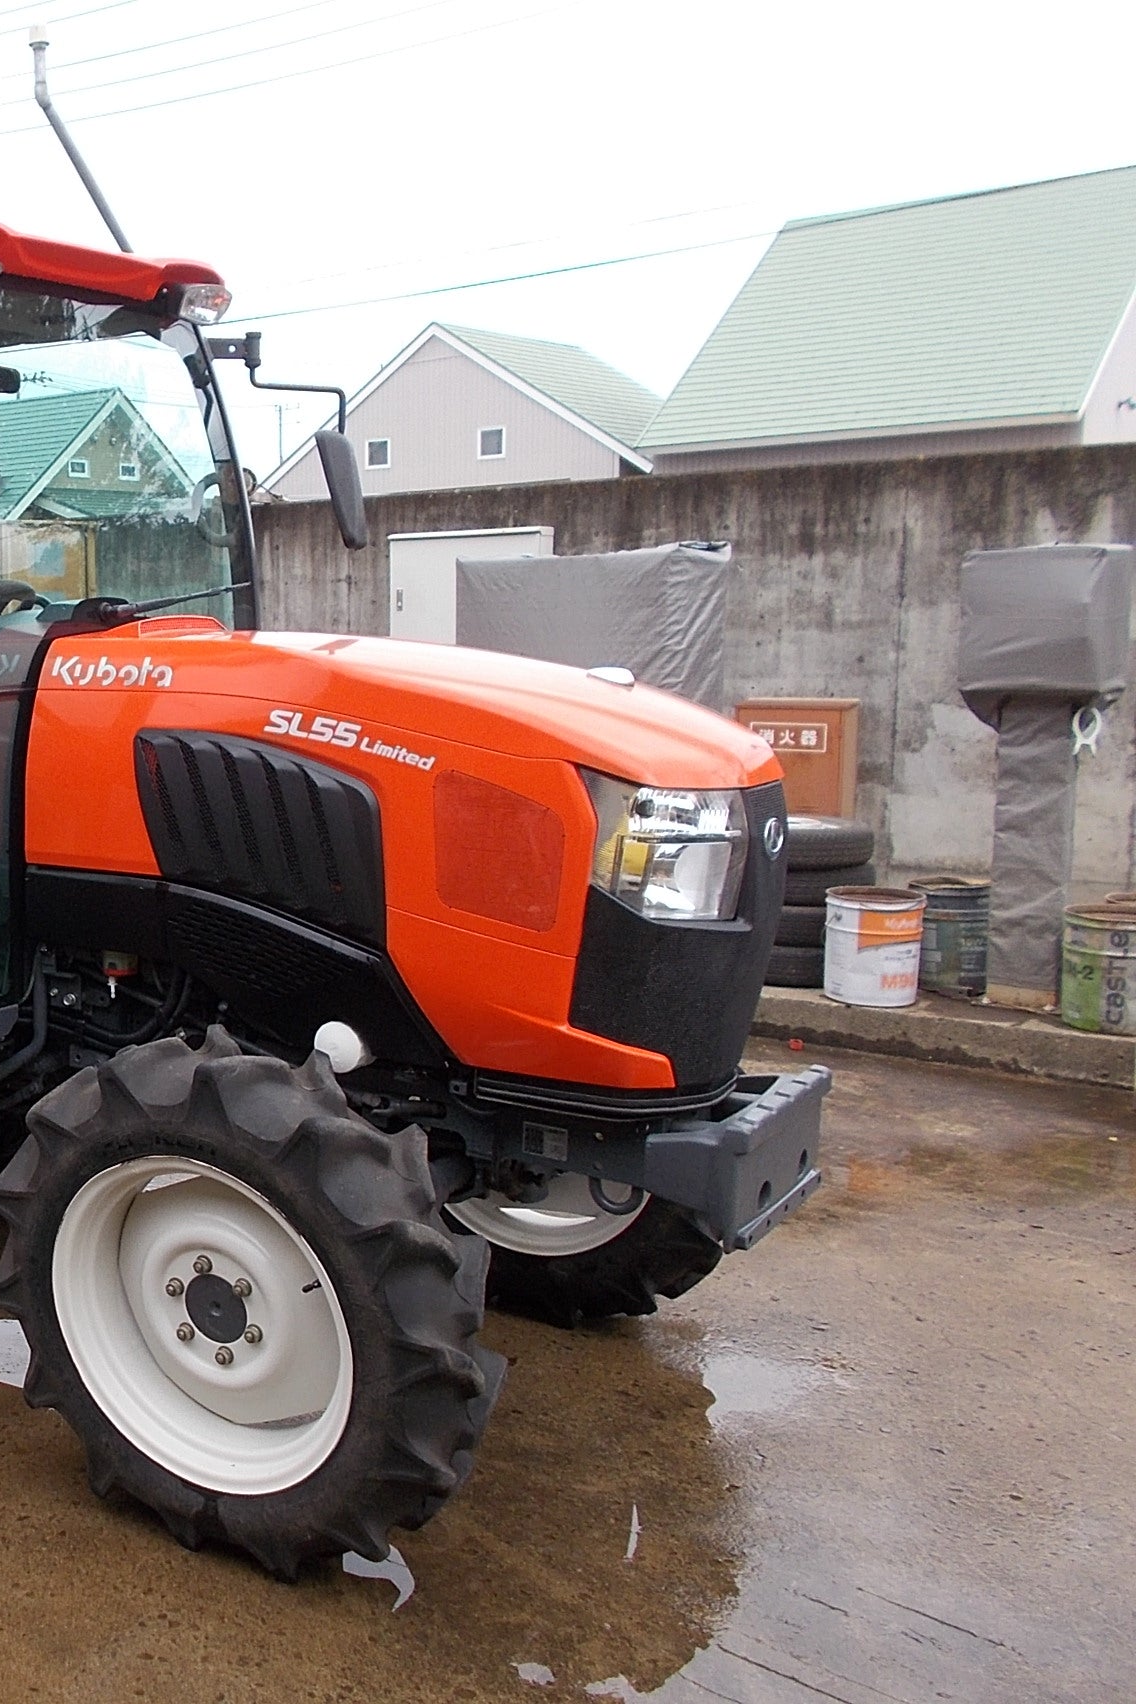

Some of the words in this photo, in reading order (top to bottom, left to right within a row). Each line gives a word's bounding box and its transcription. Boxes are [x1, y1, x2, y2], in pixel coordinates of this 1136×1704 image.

[51, 656, 174, 687] Kubota
[263, 709, 362, 748] SL55
[359, 737, 436, 771] Limited
